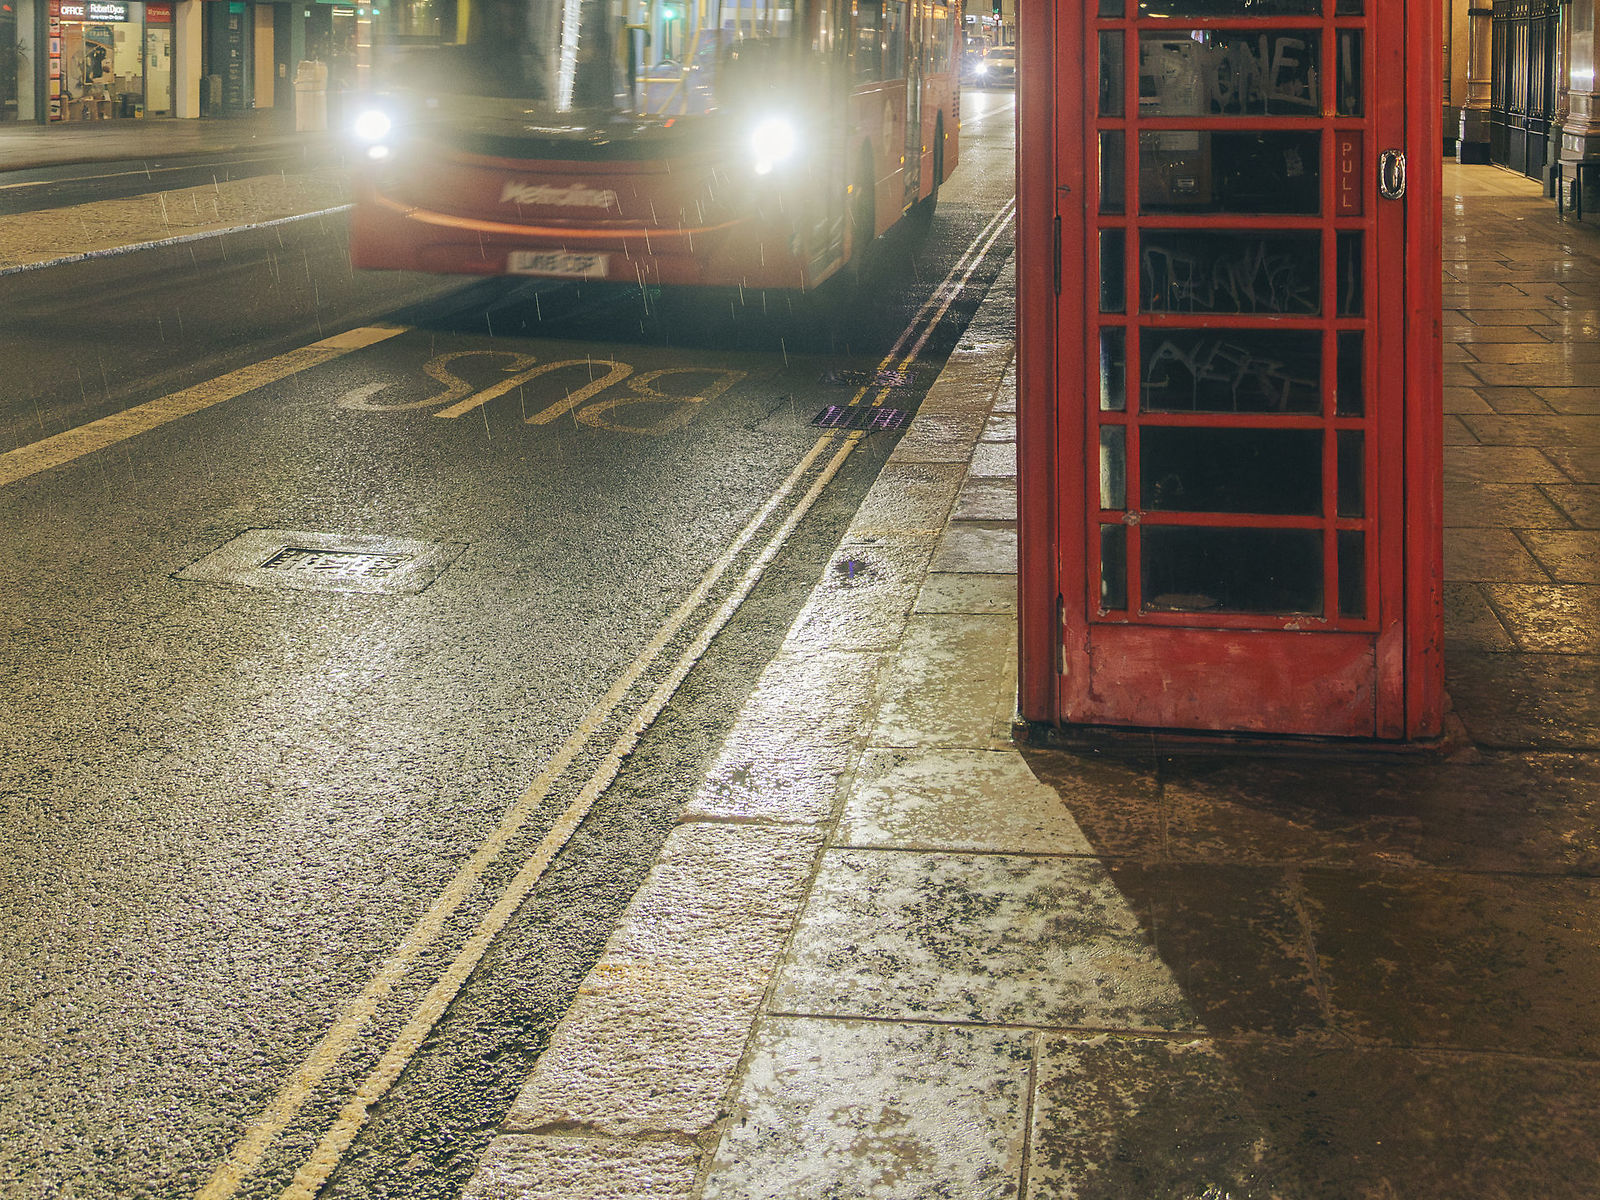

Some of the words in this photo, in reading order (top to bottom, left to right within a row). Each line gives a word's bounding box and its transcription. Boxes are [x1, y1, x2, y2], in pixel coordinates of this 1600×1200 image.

[61, 6, 85, 16] OFFICE
[90, 3, 111, 14] Robert
[110, 4, 125, 16] Dyas
[1342, 142, 1353, 209] PULL
[335, 349, 748, 436] BUS
